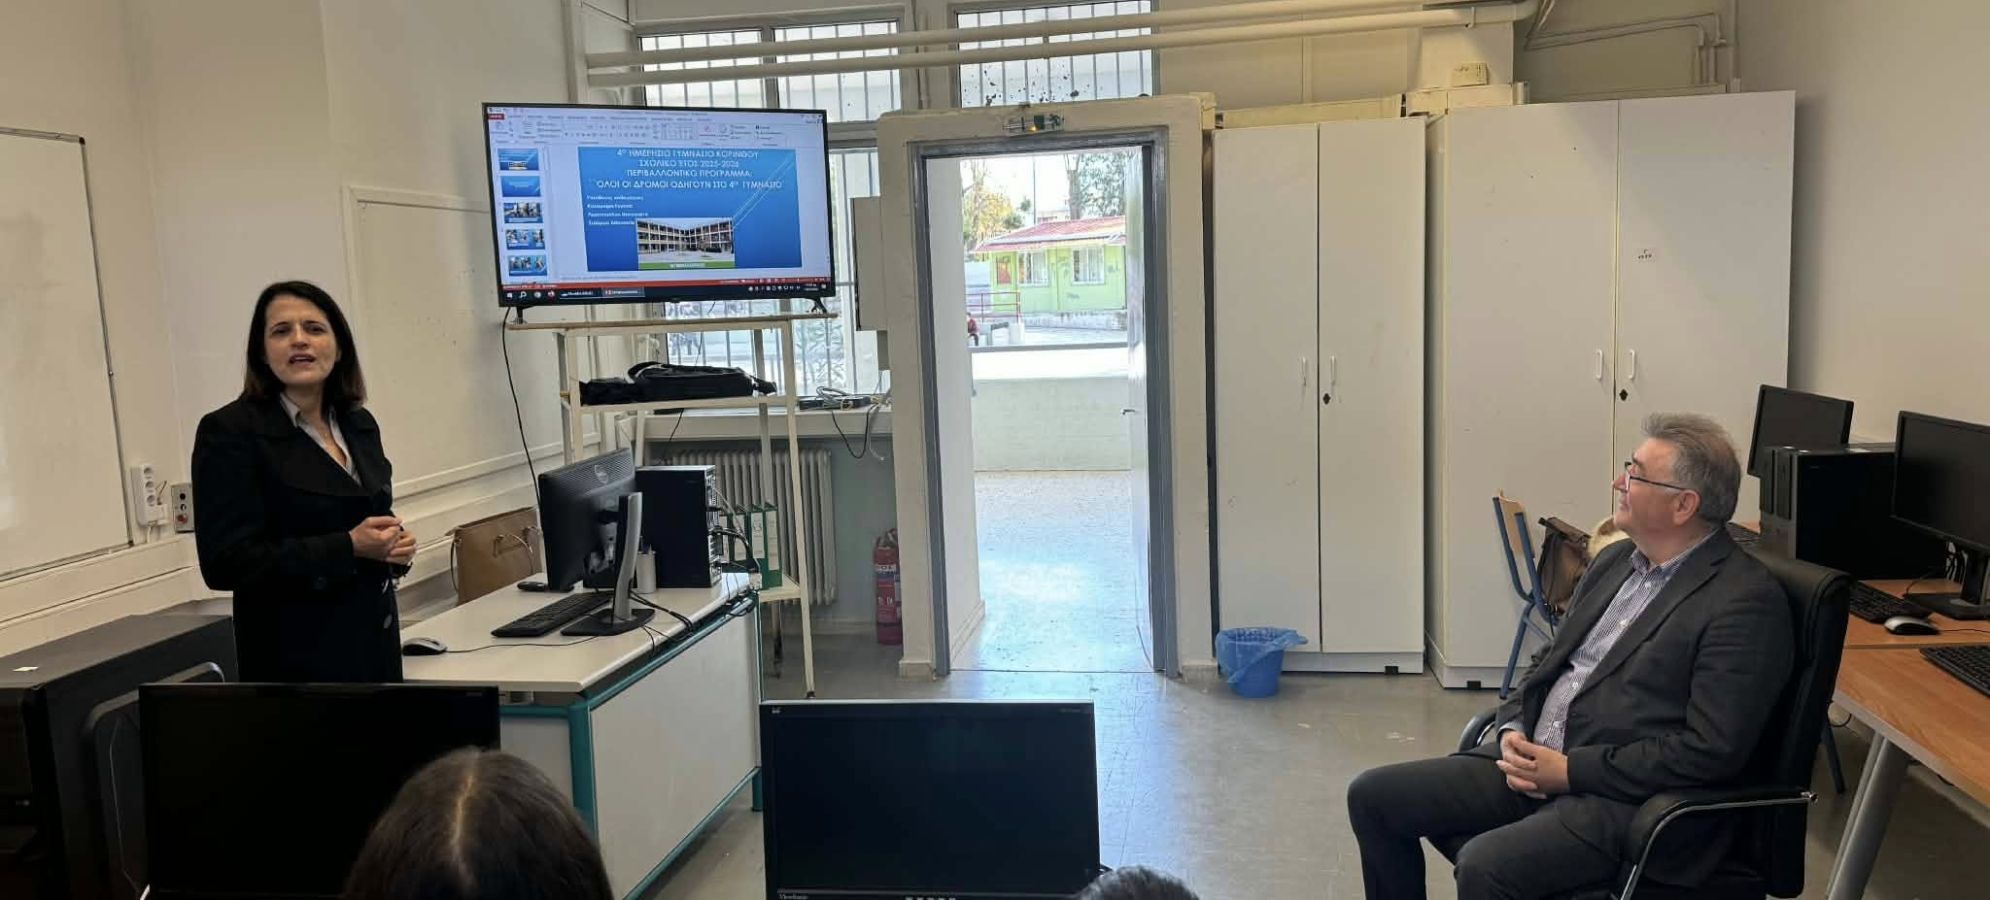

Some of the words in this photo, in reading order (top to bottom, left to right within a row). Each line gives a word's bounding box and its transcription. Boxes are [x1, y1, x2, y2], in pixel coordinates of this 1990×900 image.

[629, 149, 671, 157] ΗΜΕΡΗΣΙΟ
[716, 150, 759, 159] ΚΟΡΙΝΘΟΥ
[639, 159, 676, 167] ΣΧΟΛΙΚΟ
[679, 159, 698, 167] ΕΤΟΣ
[700, 160, 739, 168] 2025-2026
[627, 169, 698, 177] ΠΕΡΙΒΑΛΛΟΝΤΙΚΟ
[622, 180, 631, 188] ΟΙ
[633, 180, 669, 188] ΔΡΟΜΟΙ
[671, 180, 711, 189] ΟΔΗΓΟΥΝ
[713, 181, 727, 189] ΣΤΟ
